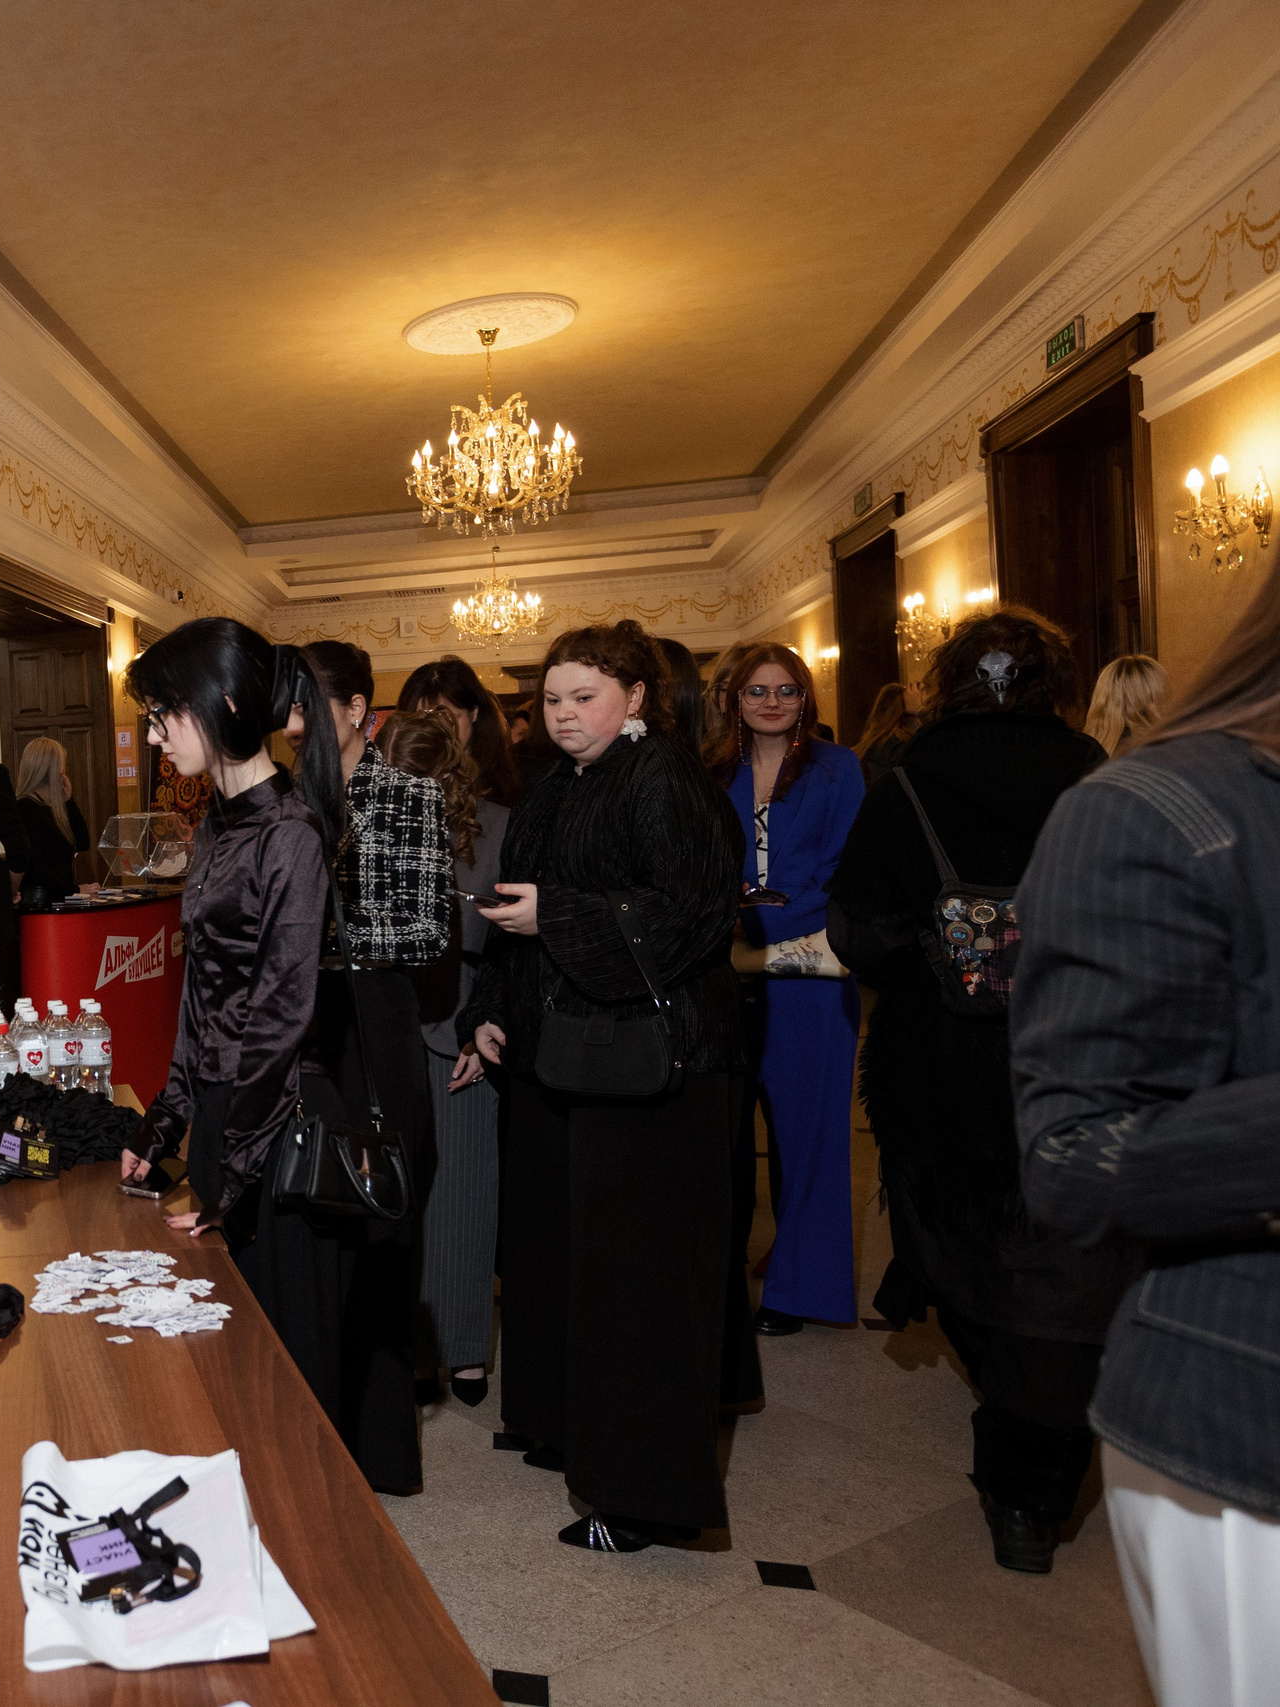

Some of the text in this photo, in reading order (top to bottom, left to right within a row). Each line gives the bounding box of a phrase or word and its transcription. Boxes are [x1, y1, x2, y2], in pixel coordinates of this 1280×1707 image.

[1048, 325, 1074, 353] ВЫХОД
[1052, 343, 1070, 364] EXIT
[104, 941, 135, 979] АЛЬФА
[128, 935, 163, 980] БУДУЩЕЕ
[85, 1548, 133, 1567] УЧАСТ
